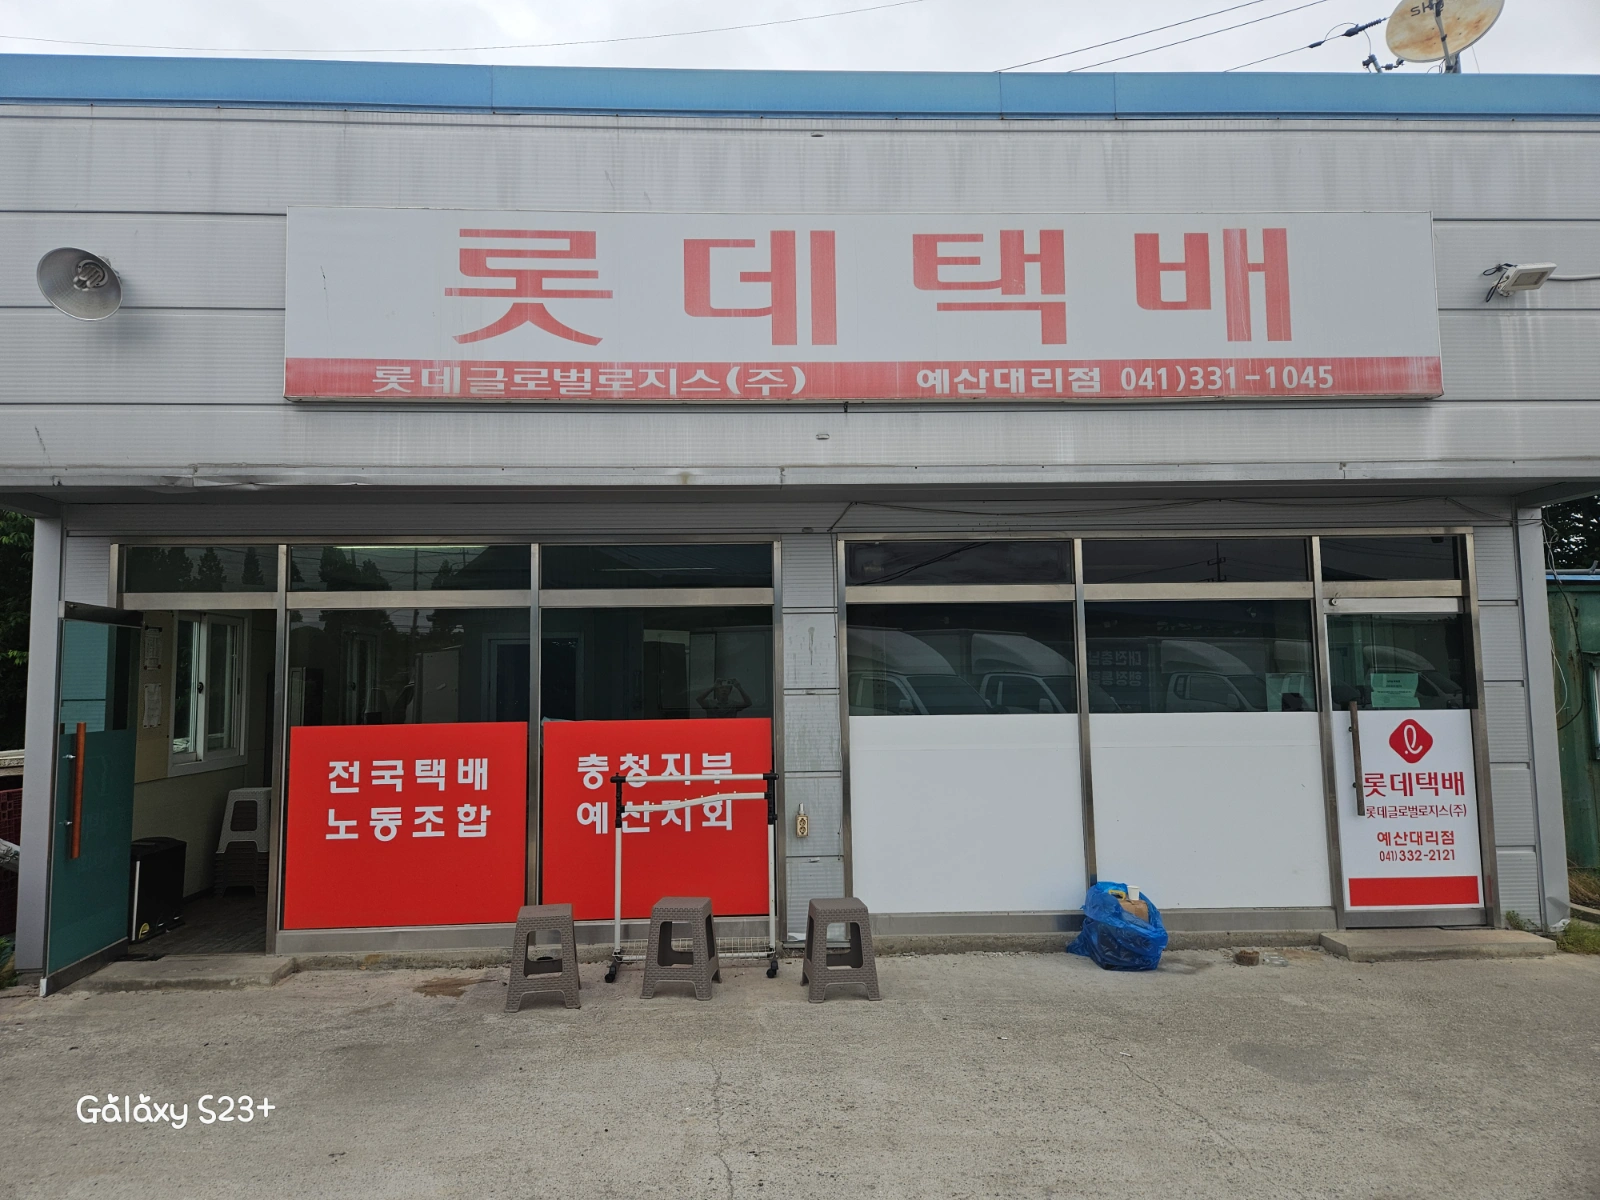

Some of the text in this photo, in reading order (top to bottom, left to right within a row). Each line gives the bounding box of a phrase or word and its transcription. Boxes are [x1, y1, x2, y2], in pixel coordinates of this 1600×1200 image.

[444, 227, 1292, 347] 롯데택배
[372, 364, 1334, 396] 롯데글로벌로지스(주) 예산대리점 041)331-1045
[328, 757, 488, 794] 전국택배
[577, 752, 733, 790] 충청지부
[1363, 771, 1465, 798] 롯데택배
[325, 803, 492, 842] 노동조합
[576, 799, 733, 835] 예산지회
[1366, 803, 1467, 819] 롯데글로벌로지스(주)
[1377, 830, 1455, 847] 예산대리점
[1379, 849, 1455, 862] 041)332-2121
